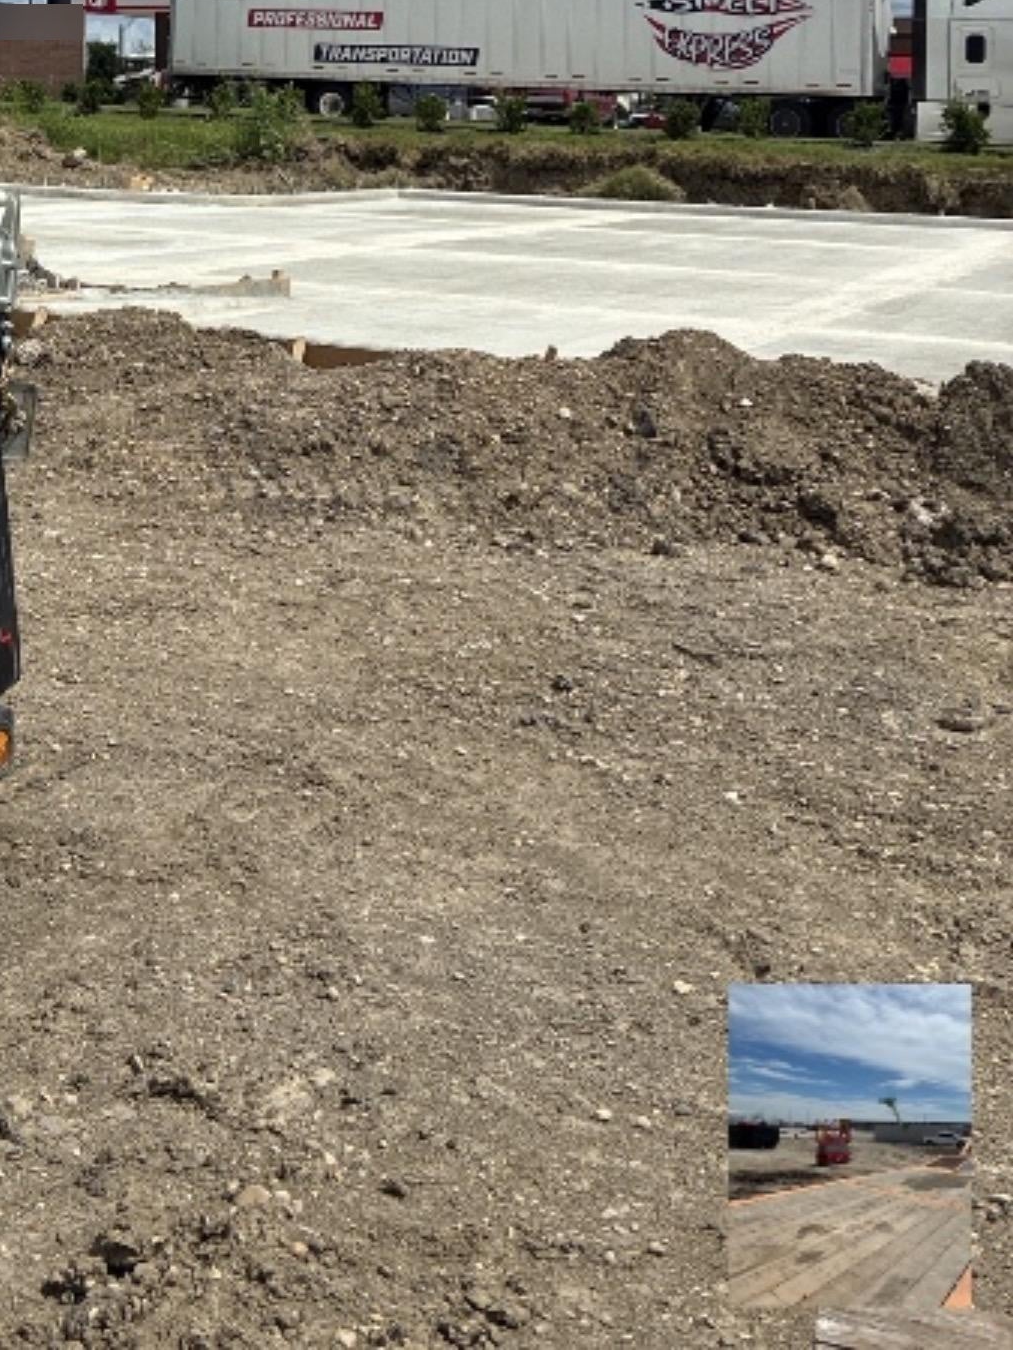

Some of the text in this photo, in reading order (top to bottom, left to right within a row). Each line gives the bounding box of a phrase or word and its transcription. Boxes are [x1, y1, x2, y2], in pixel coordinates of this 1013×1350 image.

[252, 11, 380, 29] PROFESSIONAL
[320, 46, 475, 65] TRANSPORTATION
[665, 26, 772, 67] EXPRESS
